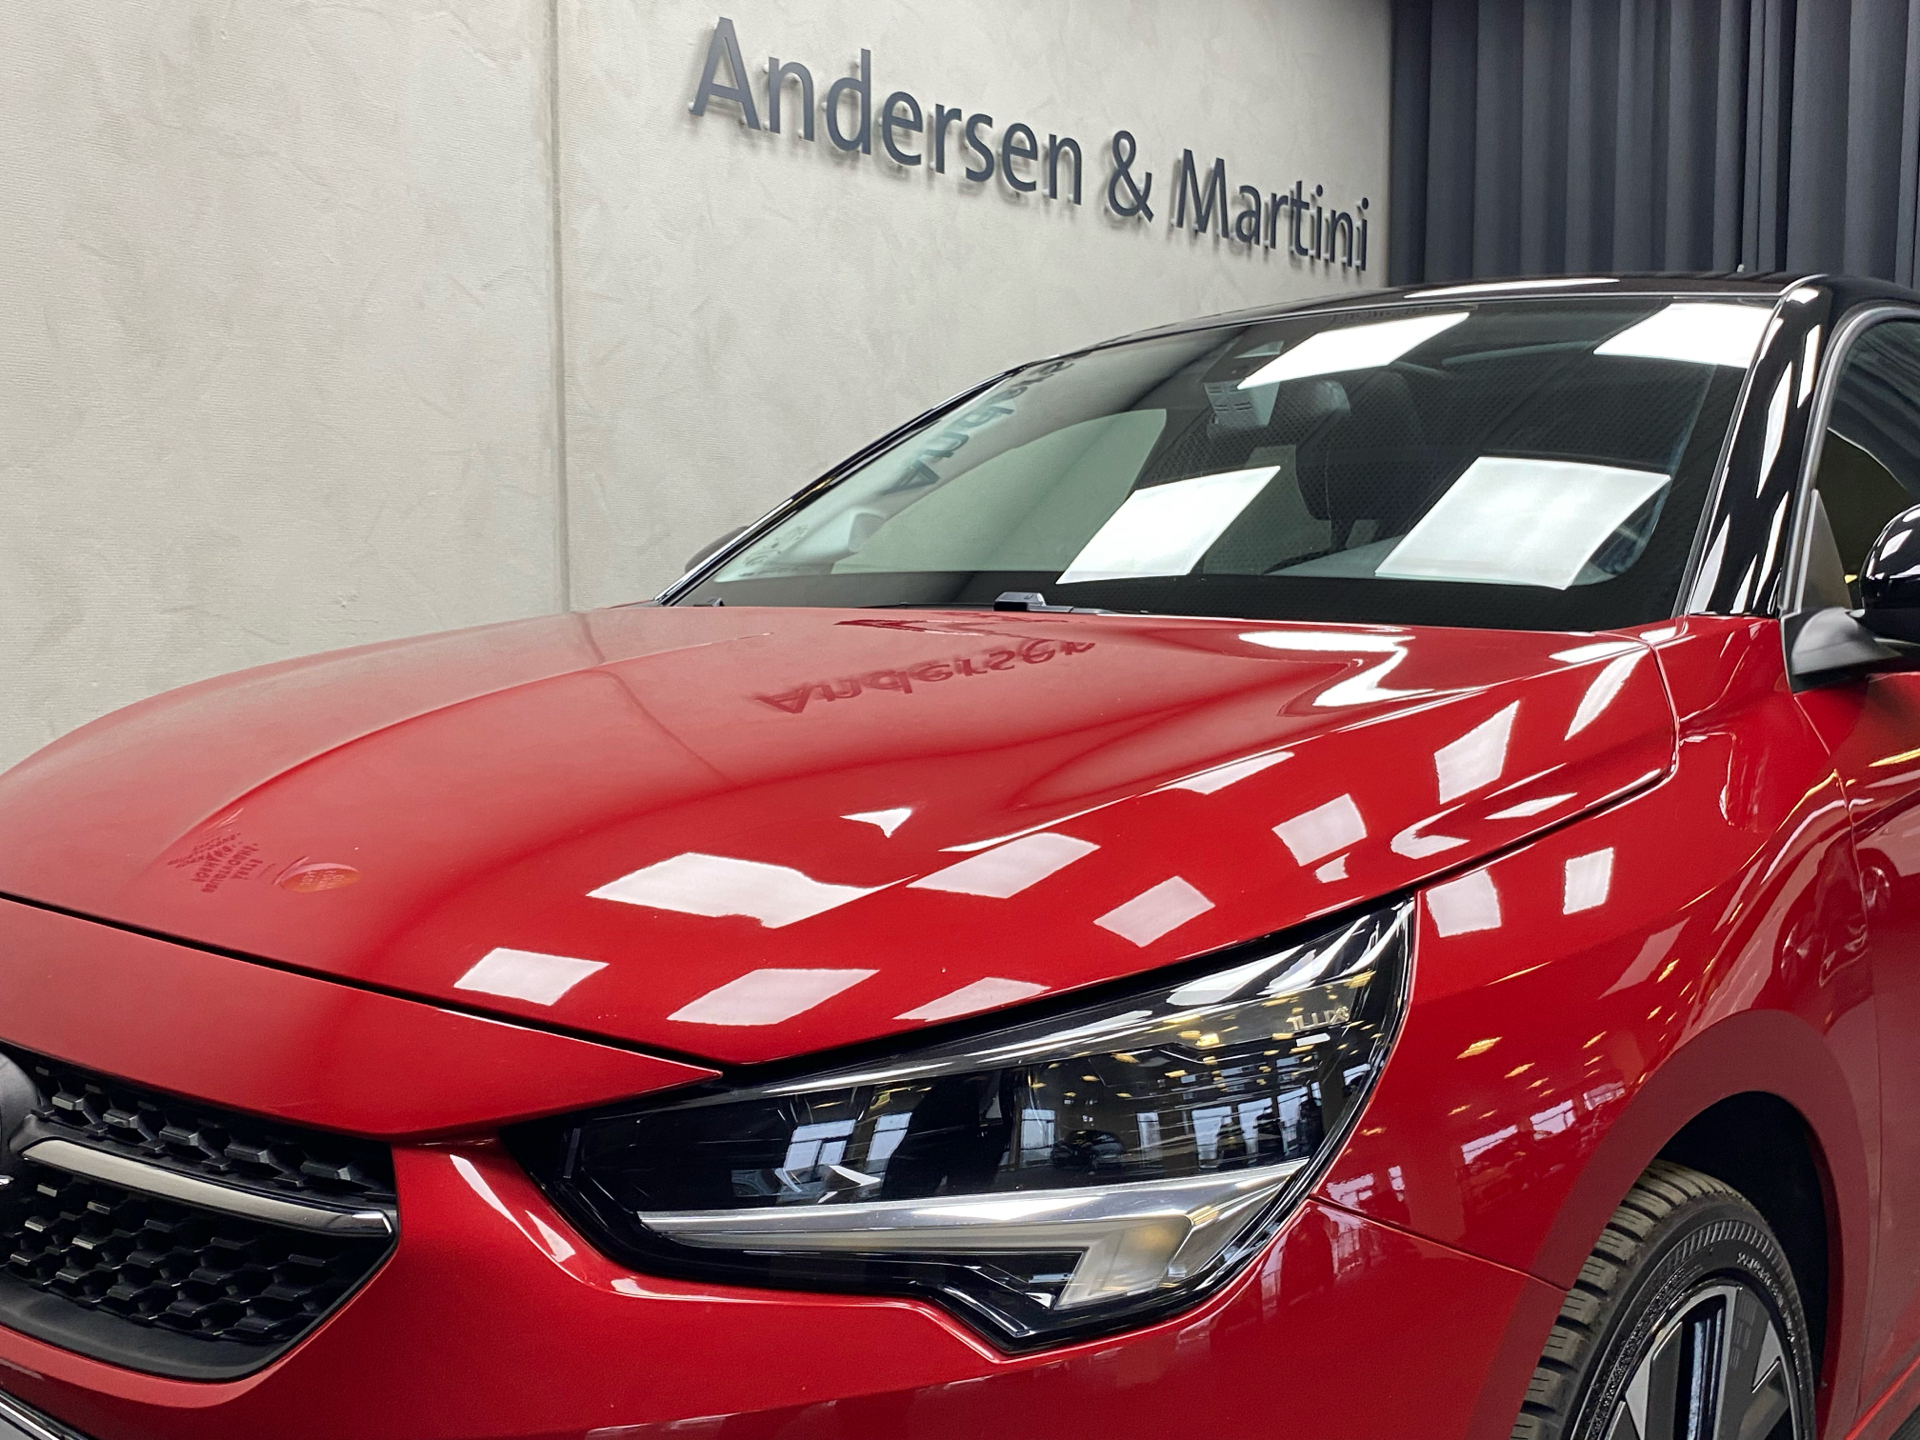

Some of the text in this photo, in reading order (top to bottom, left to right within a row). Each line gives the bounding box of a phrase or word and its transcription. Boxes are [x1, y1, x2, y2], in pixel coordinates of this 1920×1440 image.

[691, 17, 1369, 271] Andersen & Martini
